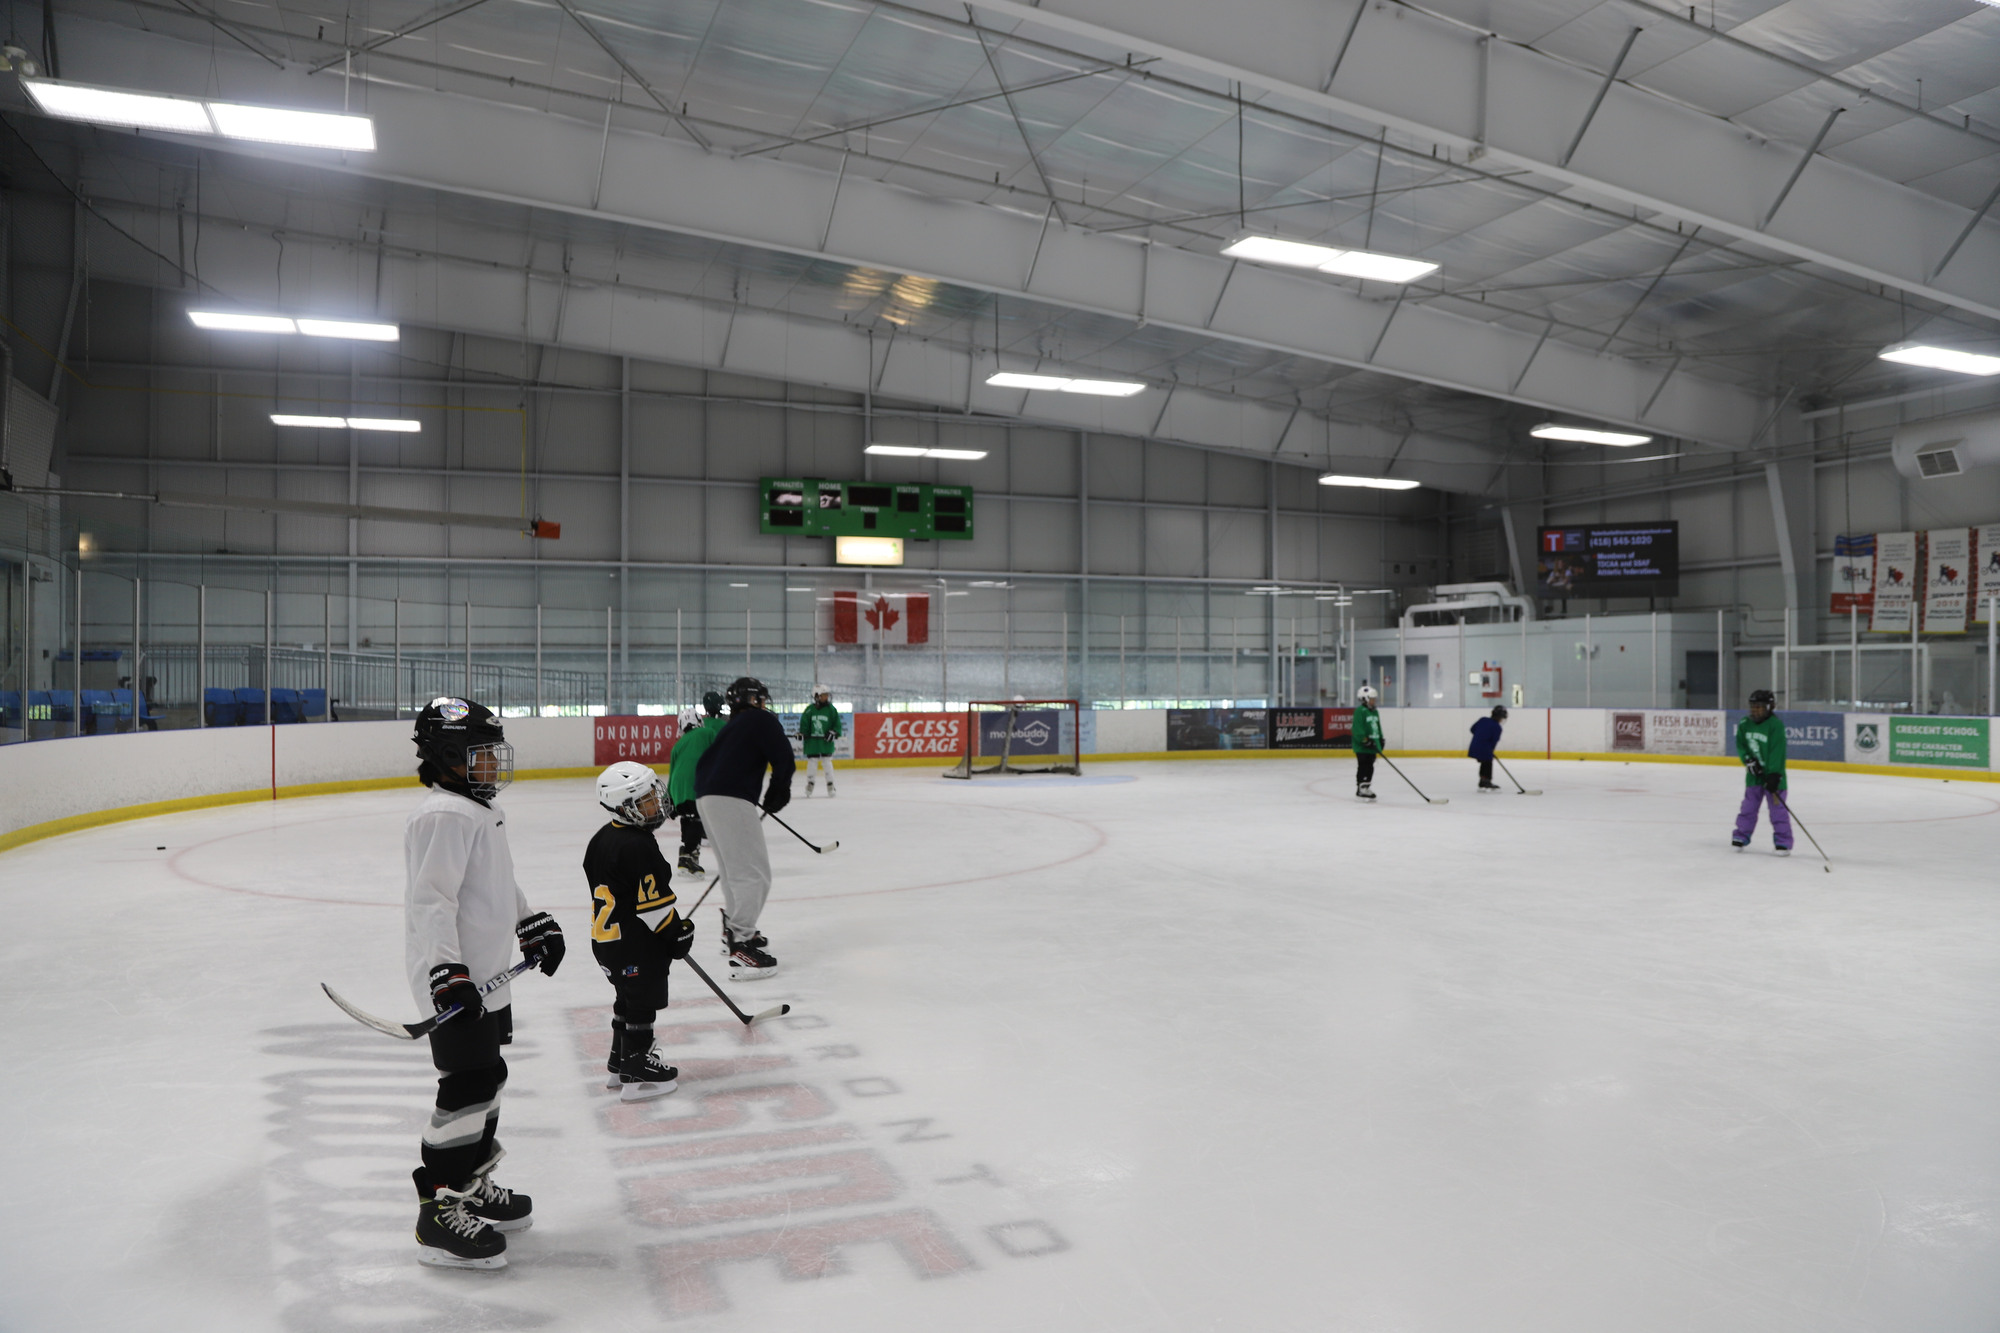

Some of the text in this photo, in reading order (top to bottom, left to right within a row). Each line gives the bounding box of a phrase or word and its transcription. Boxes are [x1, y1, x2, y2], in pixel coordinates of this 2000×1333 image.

[773, 481, 804, 489] PENALTIES
[818, 482, 842, 490] HOME
[896, 486, 920, 494] VISITOR
[933, 488, 962, 496] PENALTIES
[1653, 715, 1719, 729] FRESH BAKING
[1275, 726, 1316, 743] Wildcats
[1895, 726, 1980, 737] CRESCENT SCHOOL
[618, 742, 662, 758] CAMP
[874, 737, 960, 754] STORAGE
[1912, 742, 1921, 750] OF
[1921, 742, 1963, 751] CHARACTER
[1895, 749, 1915, 757] FROM
[1916, 750, 1934, 758] BOYS
[1935, 750, 1944, 758] OF
[591, 883, 622, 944] 2
